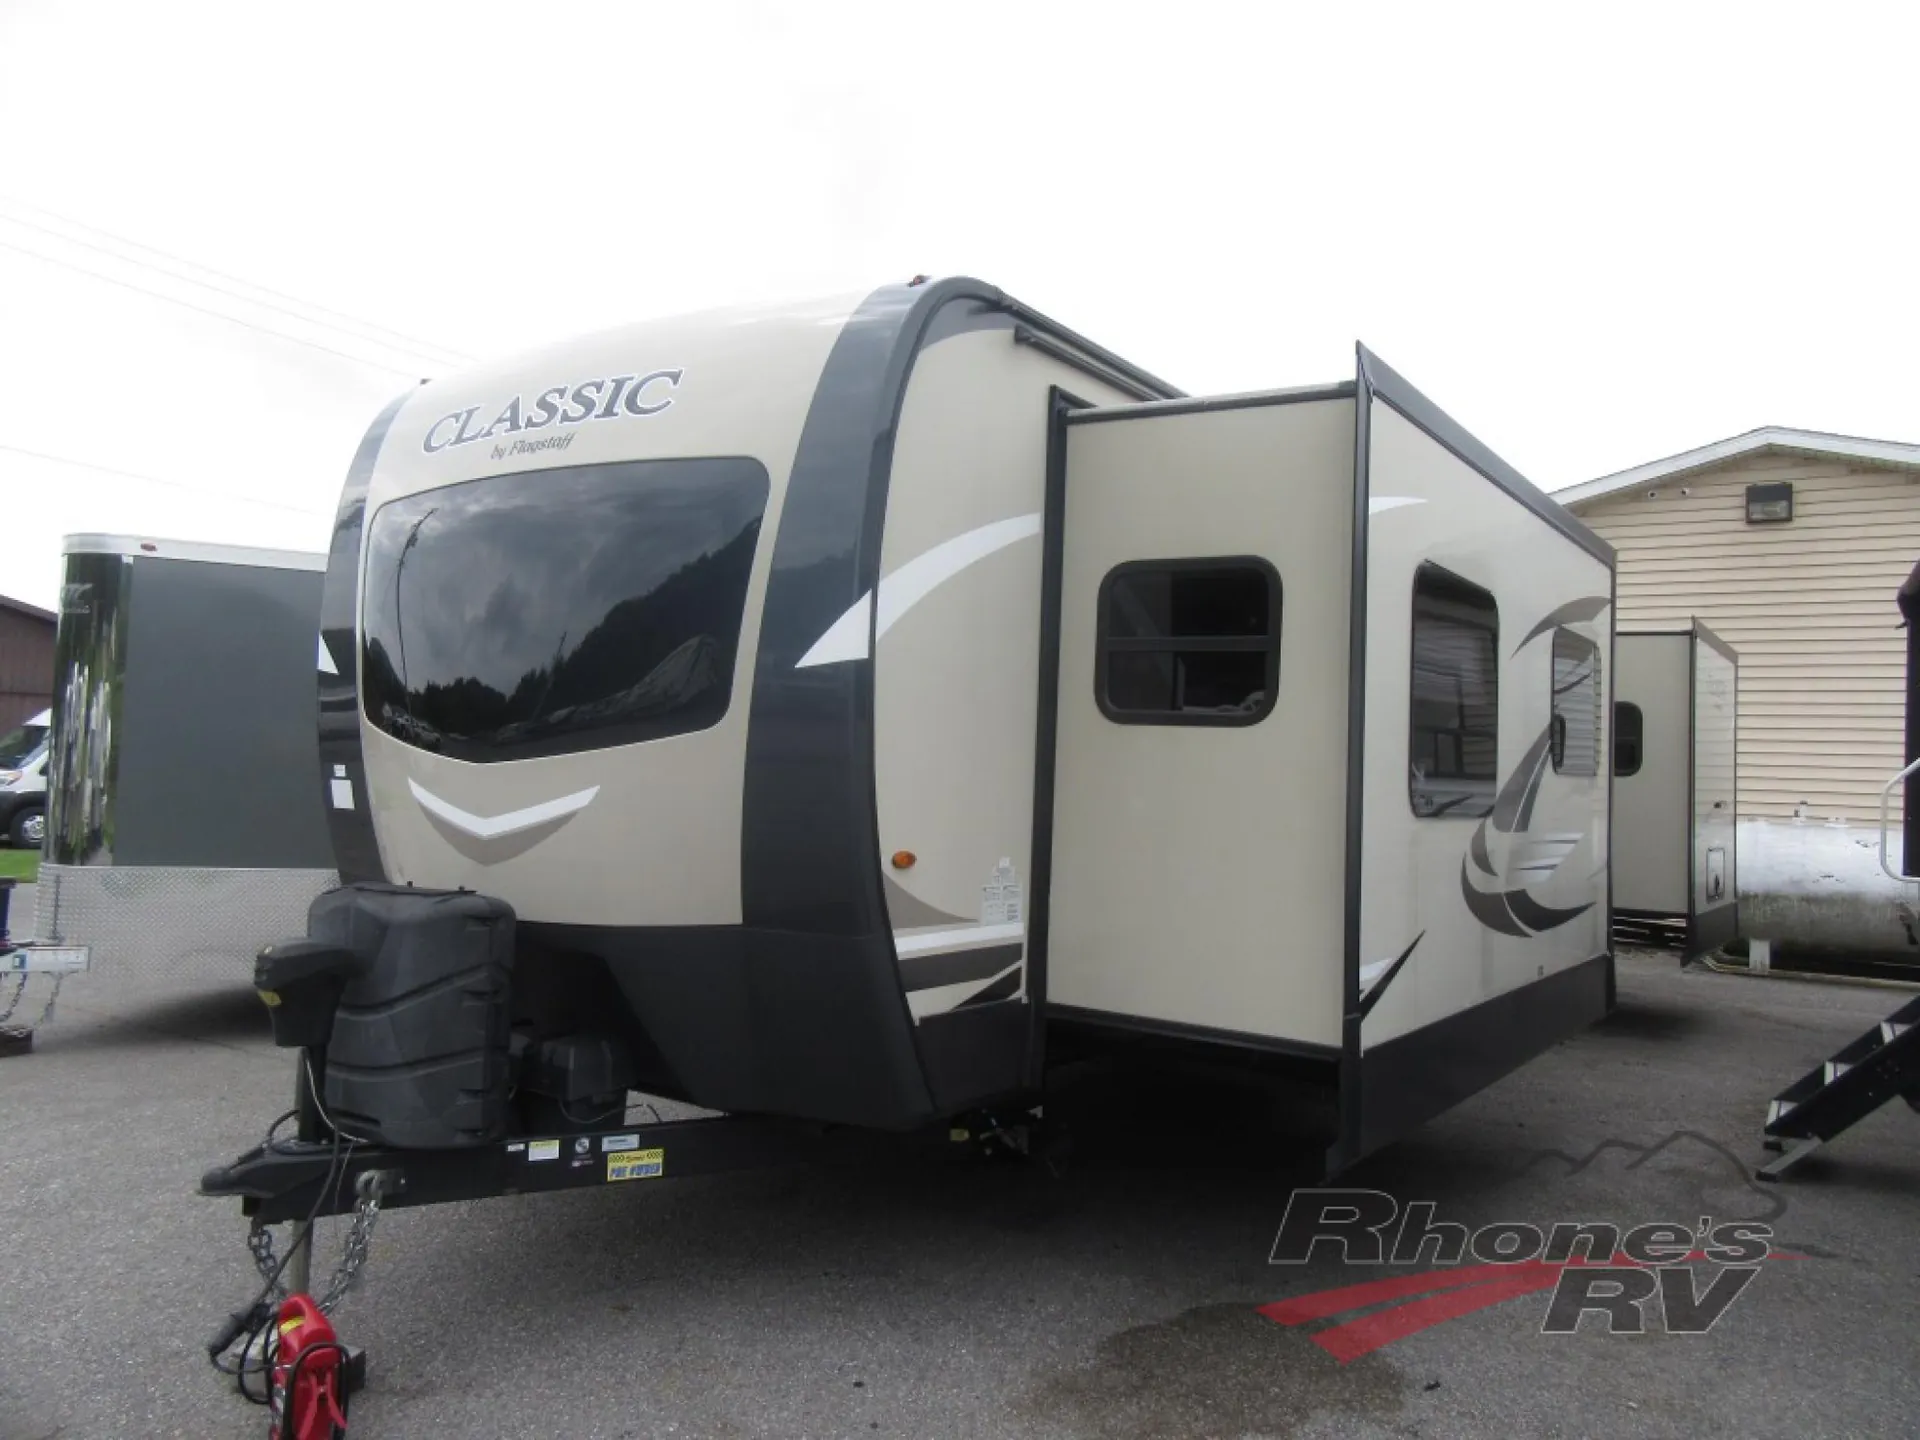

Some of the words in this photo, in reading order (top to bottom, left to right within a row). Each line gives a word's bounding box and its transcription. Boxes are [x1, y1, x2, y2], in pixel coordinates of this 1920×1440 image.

[423, 367, 684, 453] CLASSIC
[490, 443, 507, 460] by
[508, 431, 577, 456] Flagstaff
